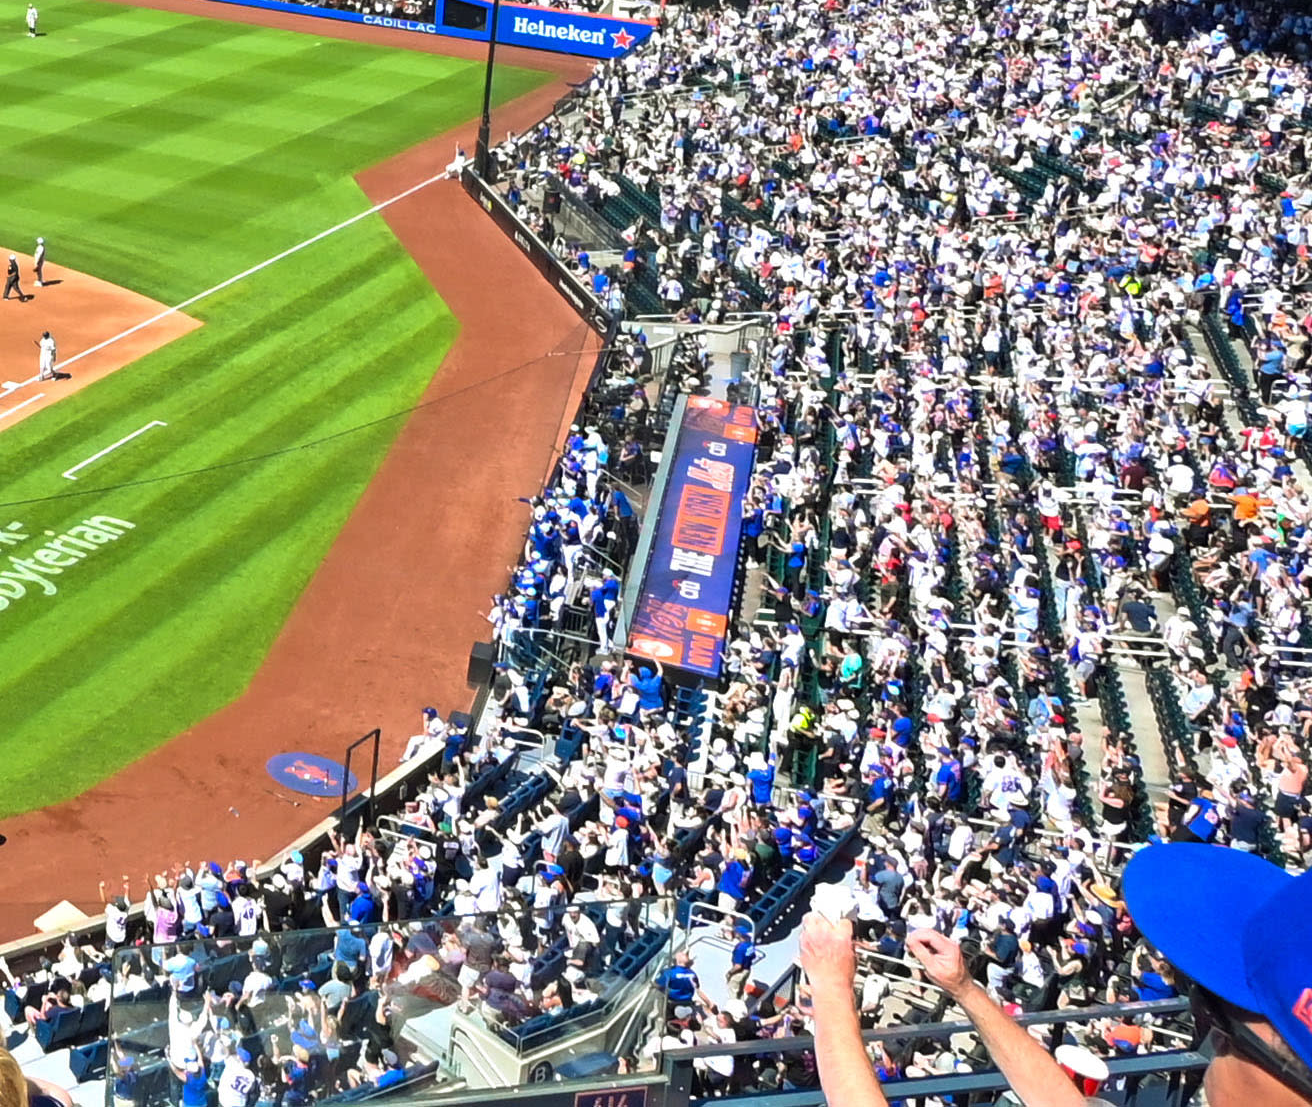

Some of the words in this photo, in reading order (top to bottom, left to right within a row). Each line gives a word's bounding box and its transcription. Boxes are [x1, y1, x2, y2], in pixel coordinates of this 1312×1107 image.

[363, 15, 437, 33] CADILLAC
[514, 17, 605, 44] Heineken
[669, 548, 714, 577] THE
